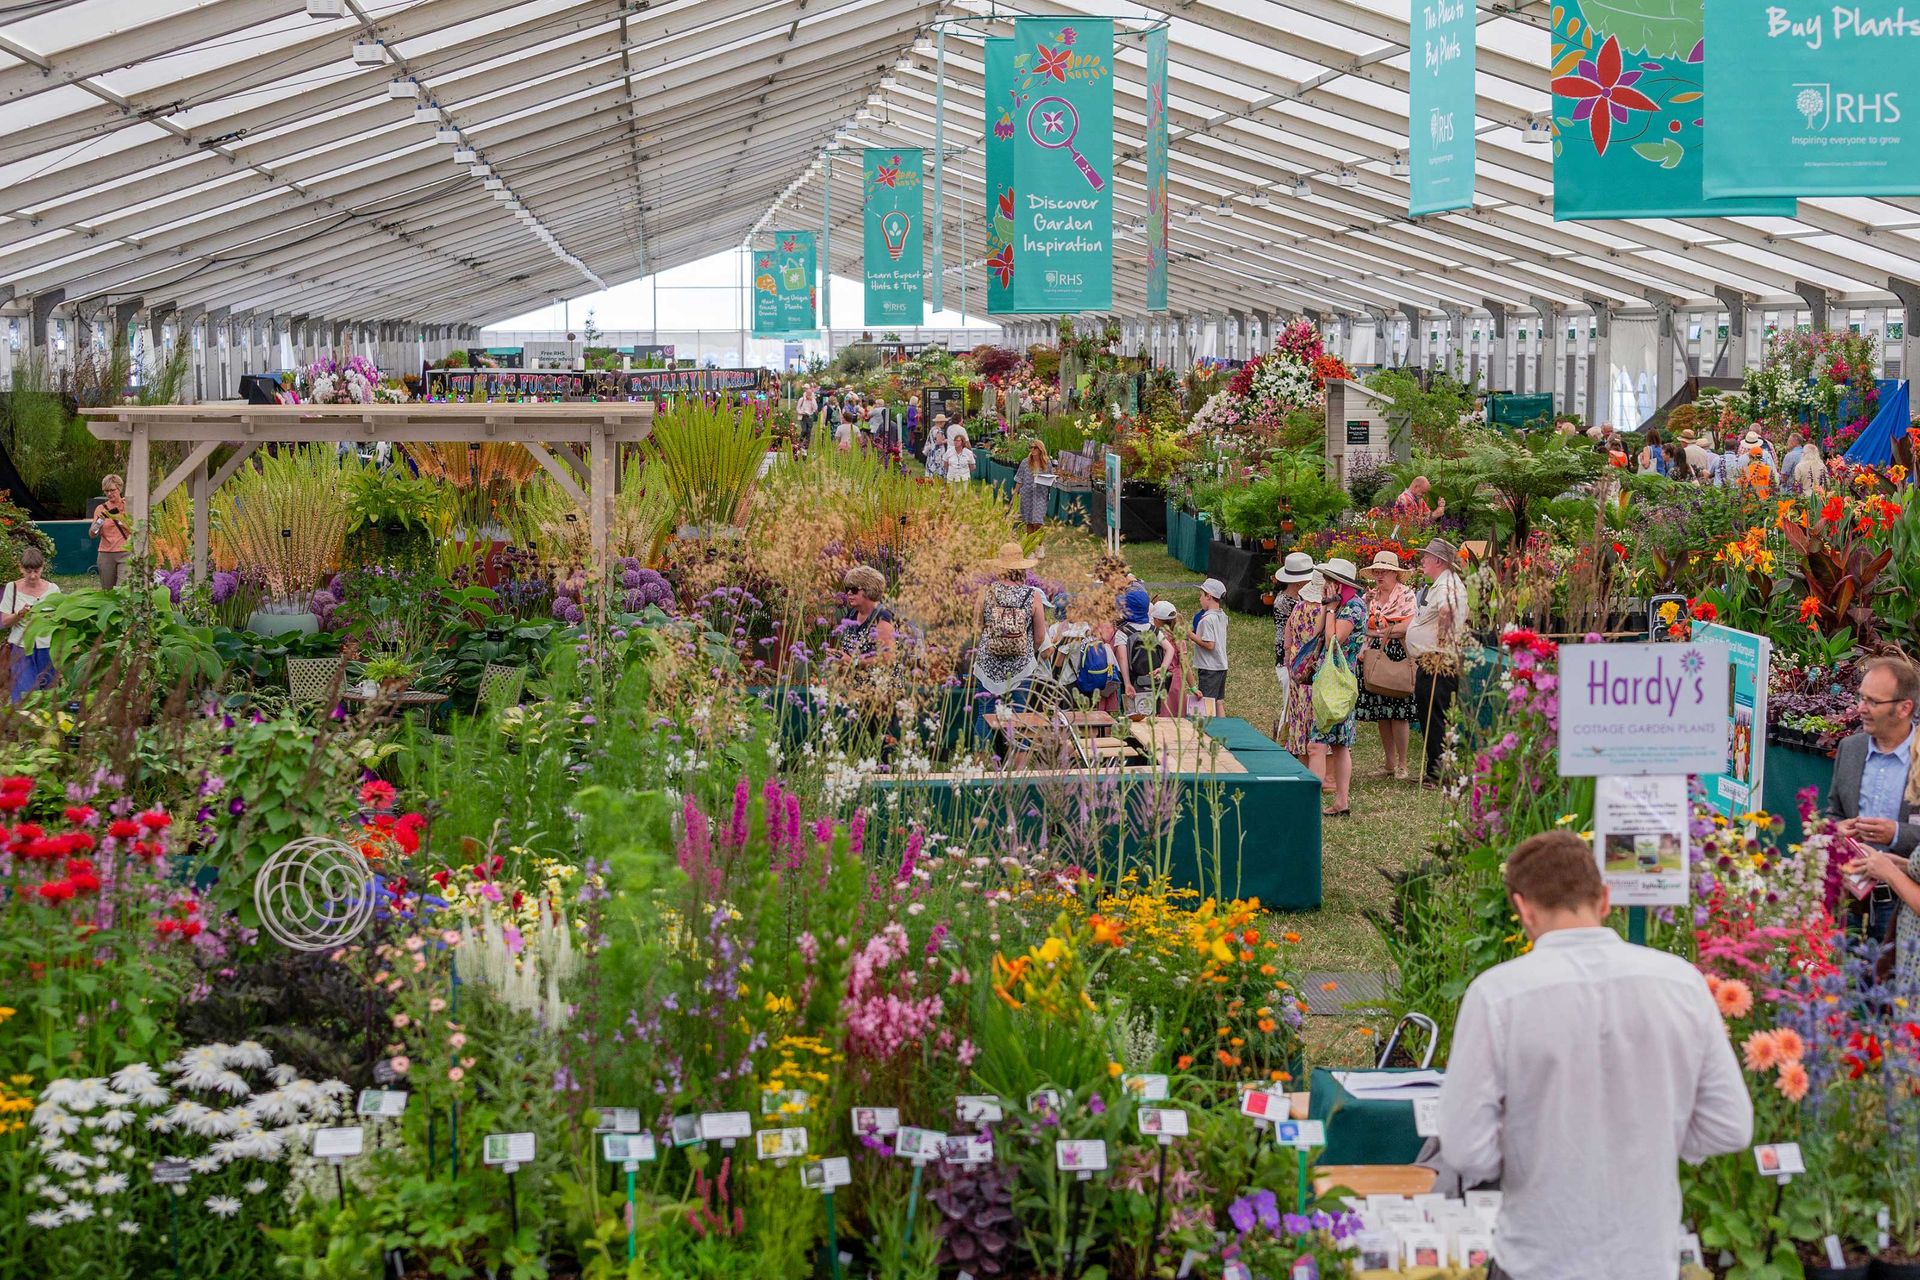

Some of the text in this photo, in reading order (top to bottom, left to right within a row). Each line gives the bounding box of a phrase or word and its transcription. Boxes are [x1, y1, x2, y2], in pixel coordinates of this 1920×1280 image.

[1765, 5, 1920, 50] Buy Plants
[1425, 32, 1461, 77] Buy Plants
[1836, 92, 1901, 123] RHS
[1439, 112, 1454, 142] RHS
[1791, 136, 1901, 147] Inspiring everyone to grow
[1026, 193, 1099, 210] Discover
[1033, 213, 1093, 231] Garden
[1023, 233, 1103, 257] Inspiration
[867, 270, 921, 281] Learn Expert
[1059, 273, 1083, 286] RHS
[871, 280, 892, 291] Hints
[901, 282, 918, 292] Tips
[519, 374, 582, 395] FUCSA
[1587, 650, 1704, 717] Hardy's
[1572, 722, 1716, 735] COTTAGE GARDEN PLANTS
